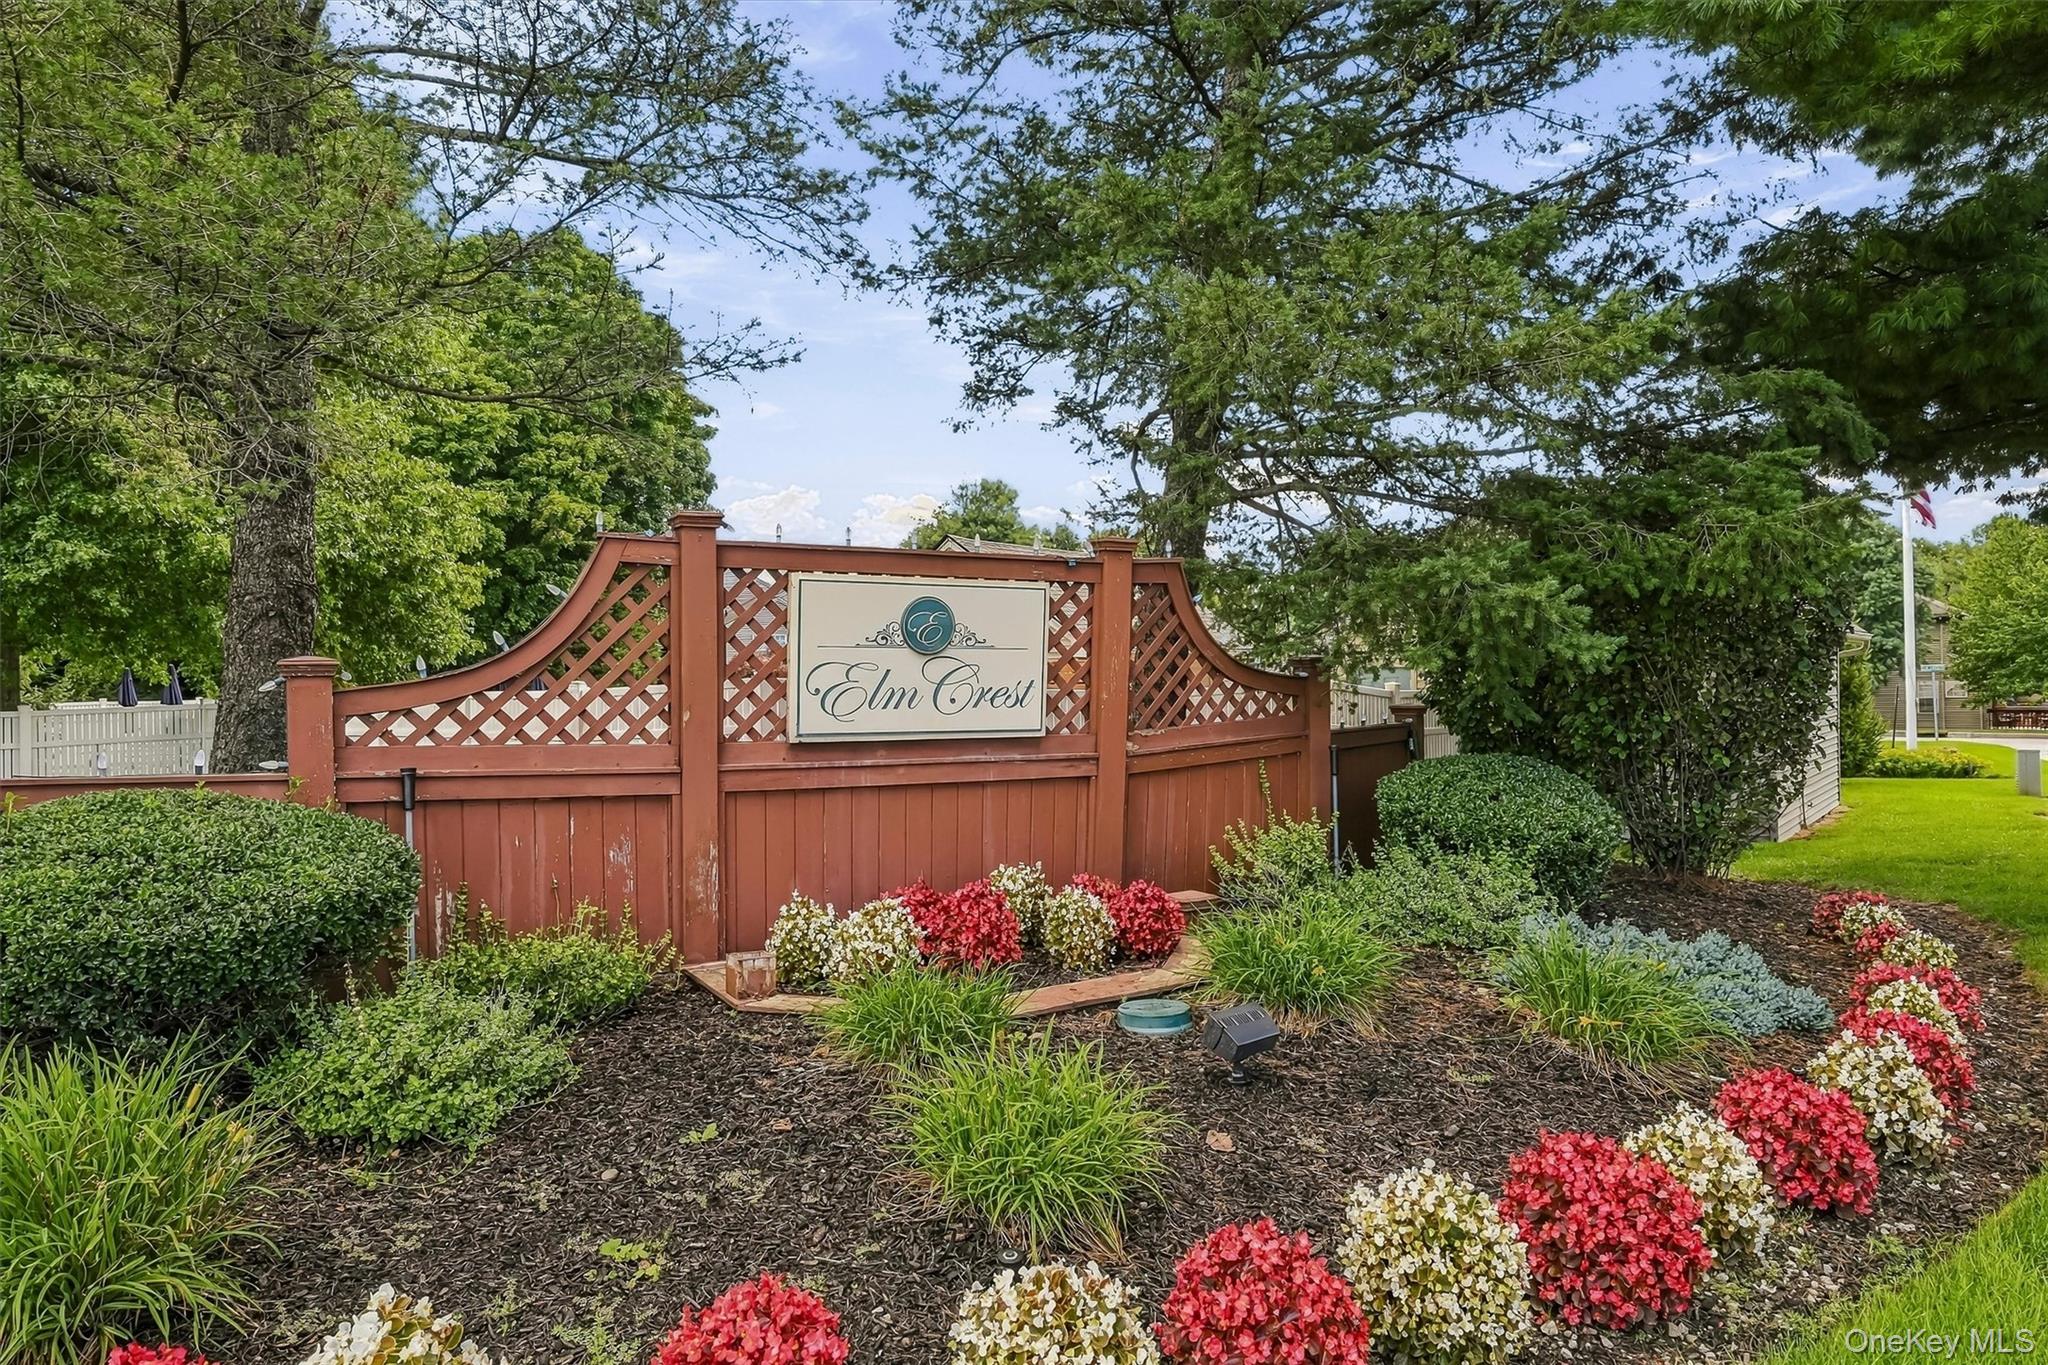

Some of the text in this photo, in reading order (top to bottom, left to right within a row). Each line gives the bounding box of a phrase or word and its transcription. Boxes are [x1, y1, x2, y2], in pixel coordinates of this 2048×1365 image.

[908, 611, 948, 645] E
[805, 655, 1036, 723] Elm Crest
